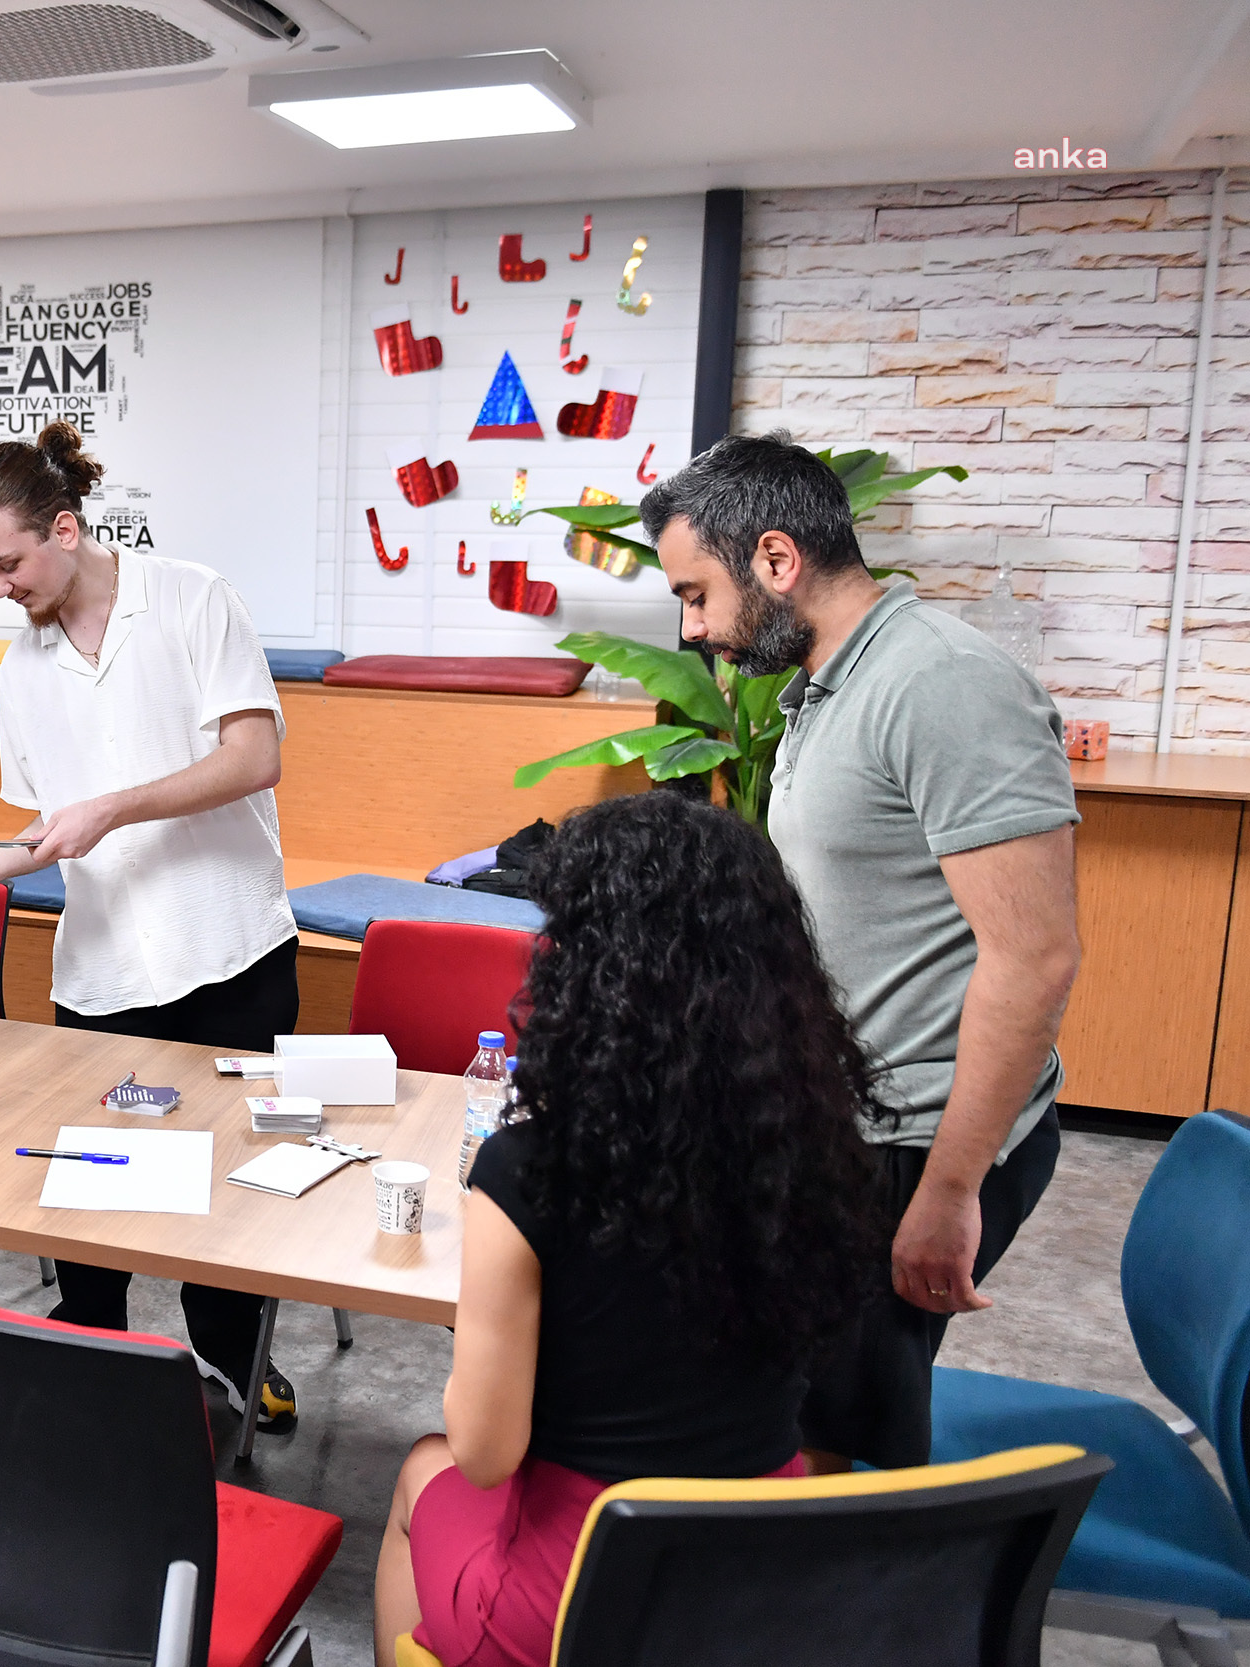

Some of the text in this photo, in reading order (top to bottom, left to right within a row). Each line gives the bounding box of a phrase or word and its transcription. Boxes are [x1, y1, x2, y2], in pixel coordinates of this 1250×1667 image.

[107, 283, 152, 299] JOBS
[10, 295, 34, 304] IDEA
[6, 301, 141, 321] LANGUAGE
[6, 320, 112, 342] FLUENCY
[74, 386, 94, 394] IDEA
[102, 516, 147, 524] SPEECH
